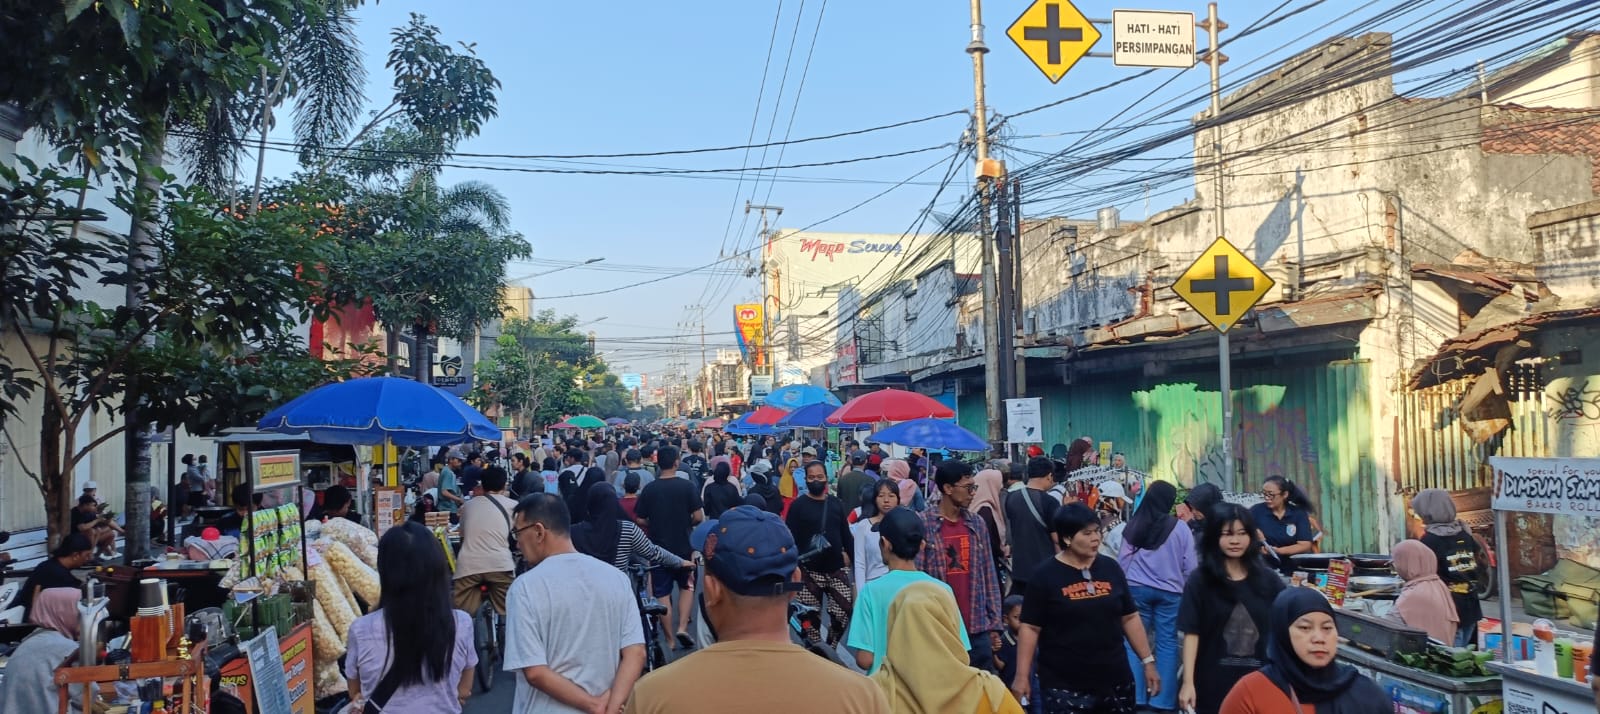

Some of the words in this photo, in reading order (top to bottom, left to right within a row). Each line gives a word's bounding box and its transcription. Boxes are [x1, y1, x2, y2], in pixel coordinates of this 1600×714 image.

[1127, 24, 1149, 34] HATI
[1158, 25, 1180, 35] HATI
[1116, 42, 1192, 54] PERSIMPANGAN
[1562, 465, 1580, 475] for
[1504, 472, 1563, 498] DIMSUM
[1527, 500, 1561, 511] BAKAR
